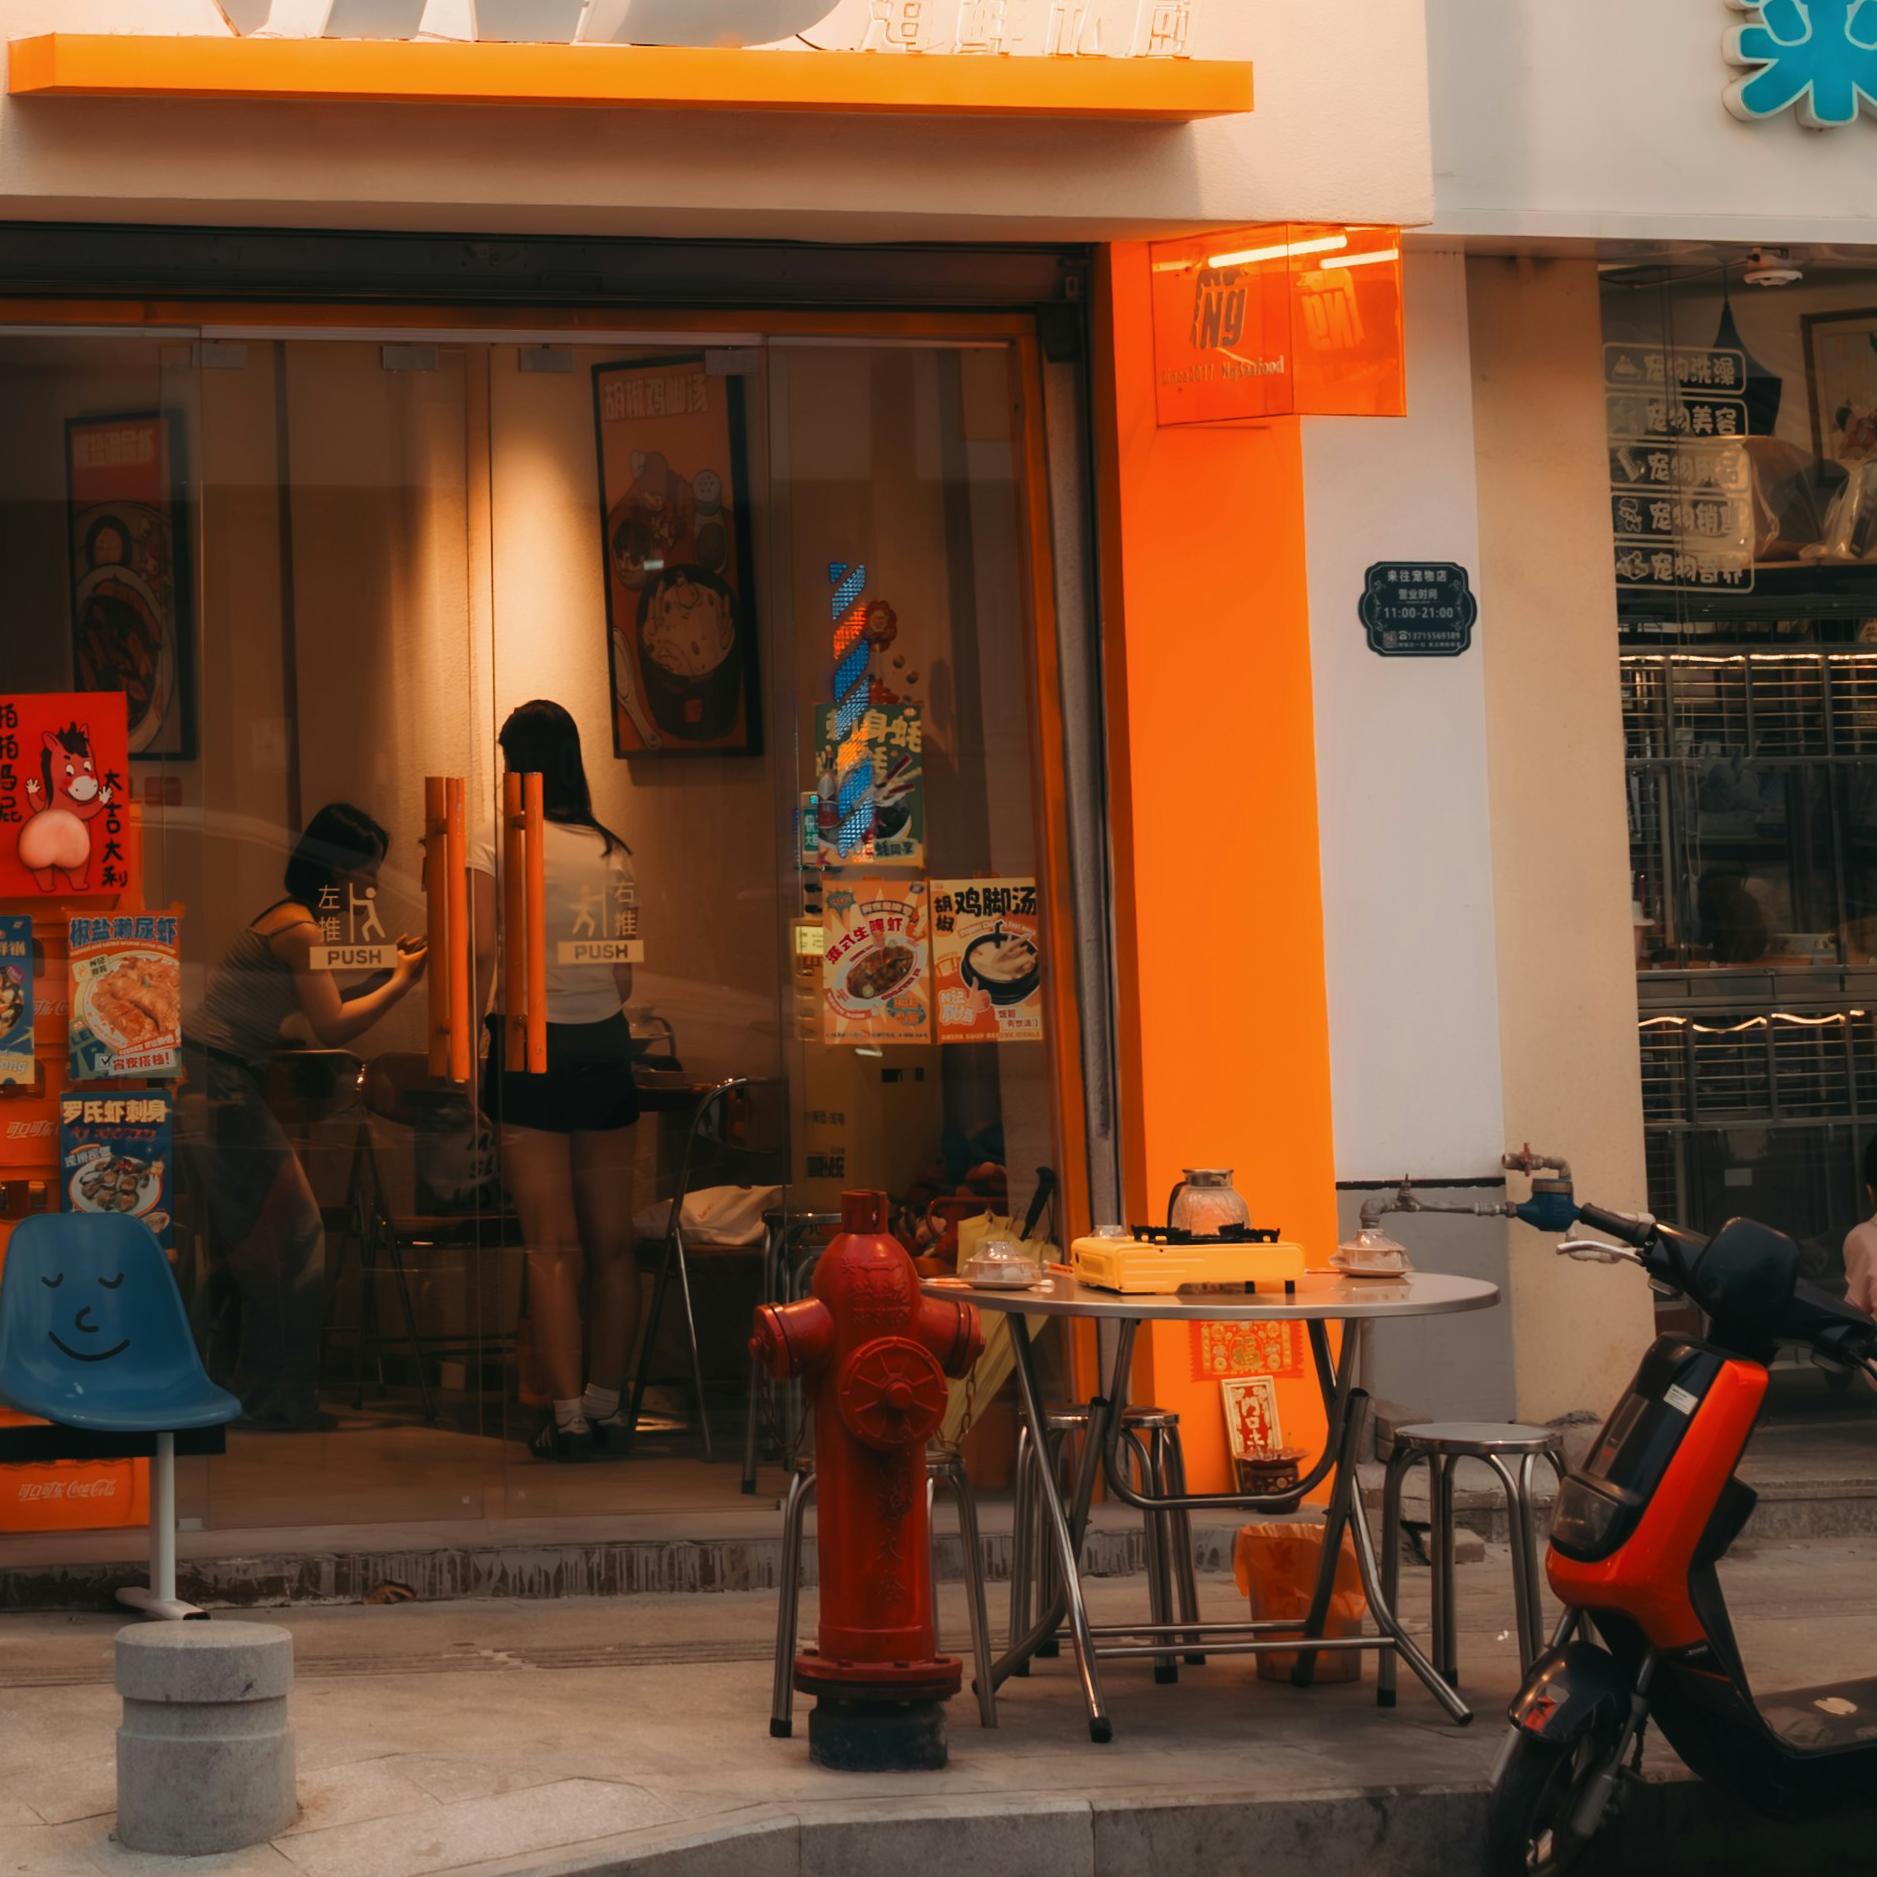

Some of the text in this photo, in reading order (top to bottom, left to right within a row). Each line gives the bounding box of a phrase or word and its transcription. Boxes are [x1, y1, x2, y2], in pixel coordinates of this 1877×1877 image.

[1644, 353, 1735, 386] 宠物洗澡
[1645, 400, 1738, 435] 宠物美容
[1387, 569, 1447, 583] 来往宠物店
[1397, 588, 1438, 600] 营业时间
[1383, 607, 1454, 619] 11:00-21:00
[100, 769, 129, 888] 大吉大利
[318, 884, 341, 944] 左推
[614, 882, 637, 937] 右推
[934, 894, 955, 933] 胡椒
[954, 886, 1037, 917] 鸡脚汤
[327, 949, 383, 966] PUSH
[574, 943, 629, 960] PUSH
[62, 1099, 167, 1124] 罗氏虾刺身
